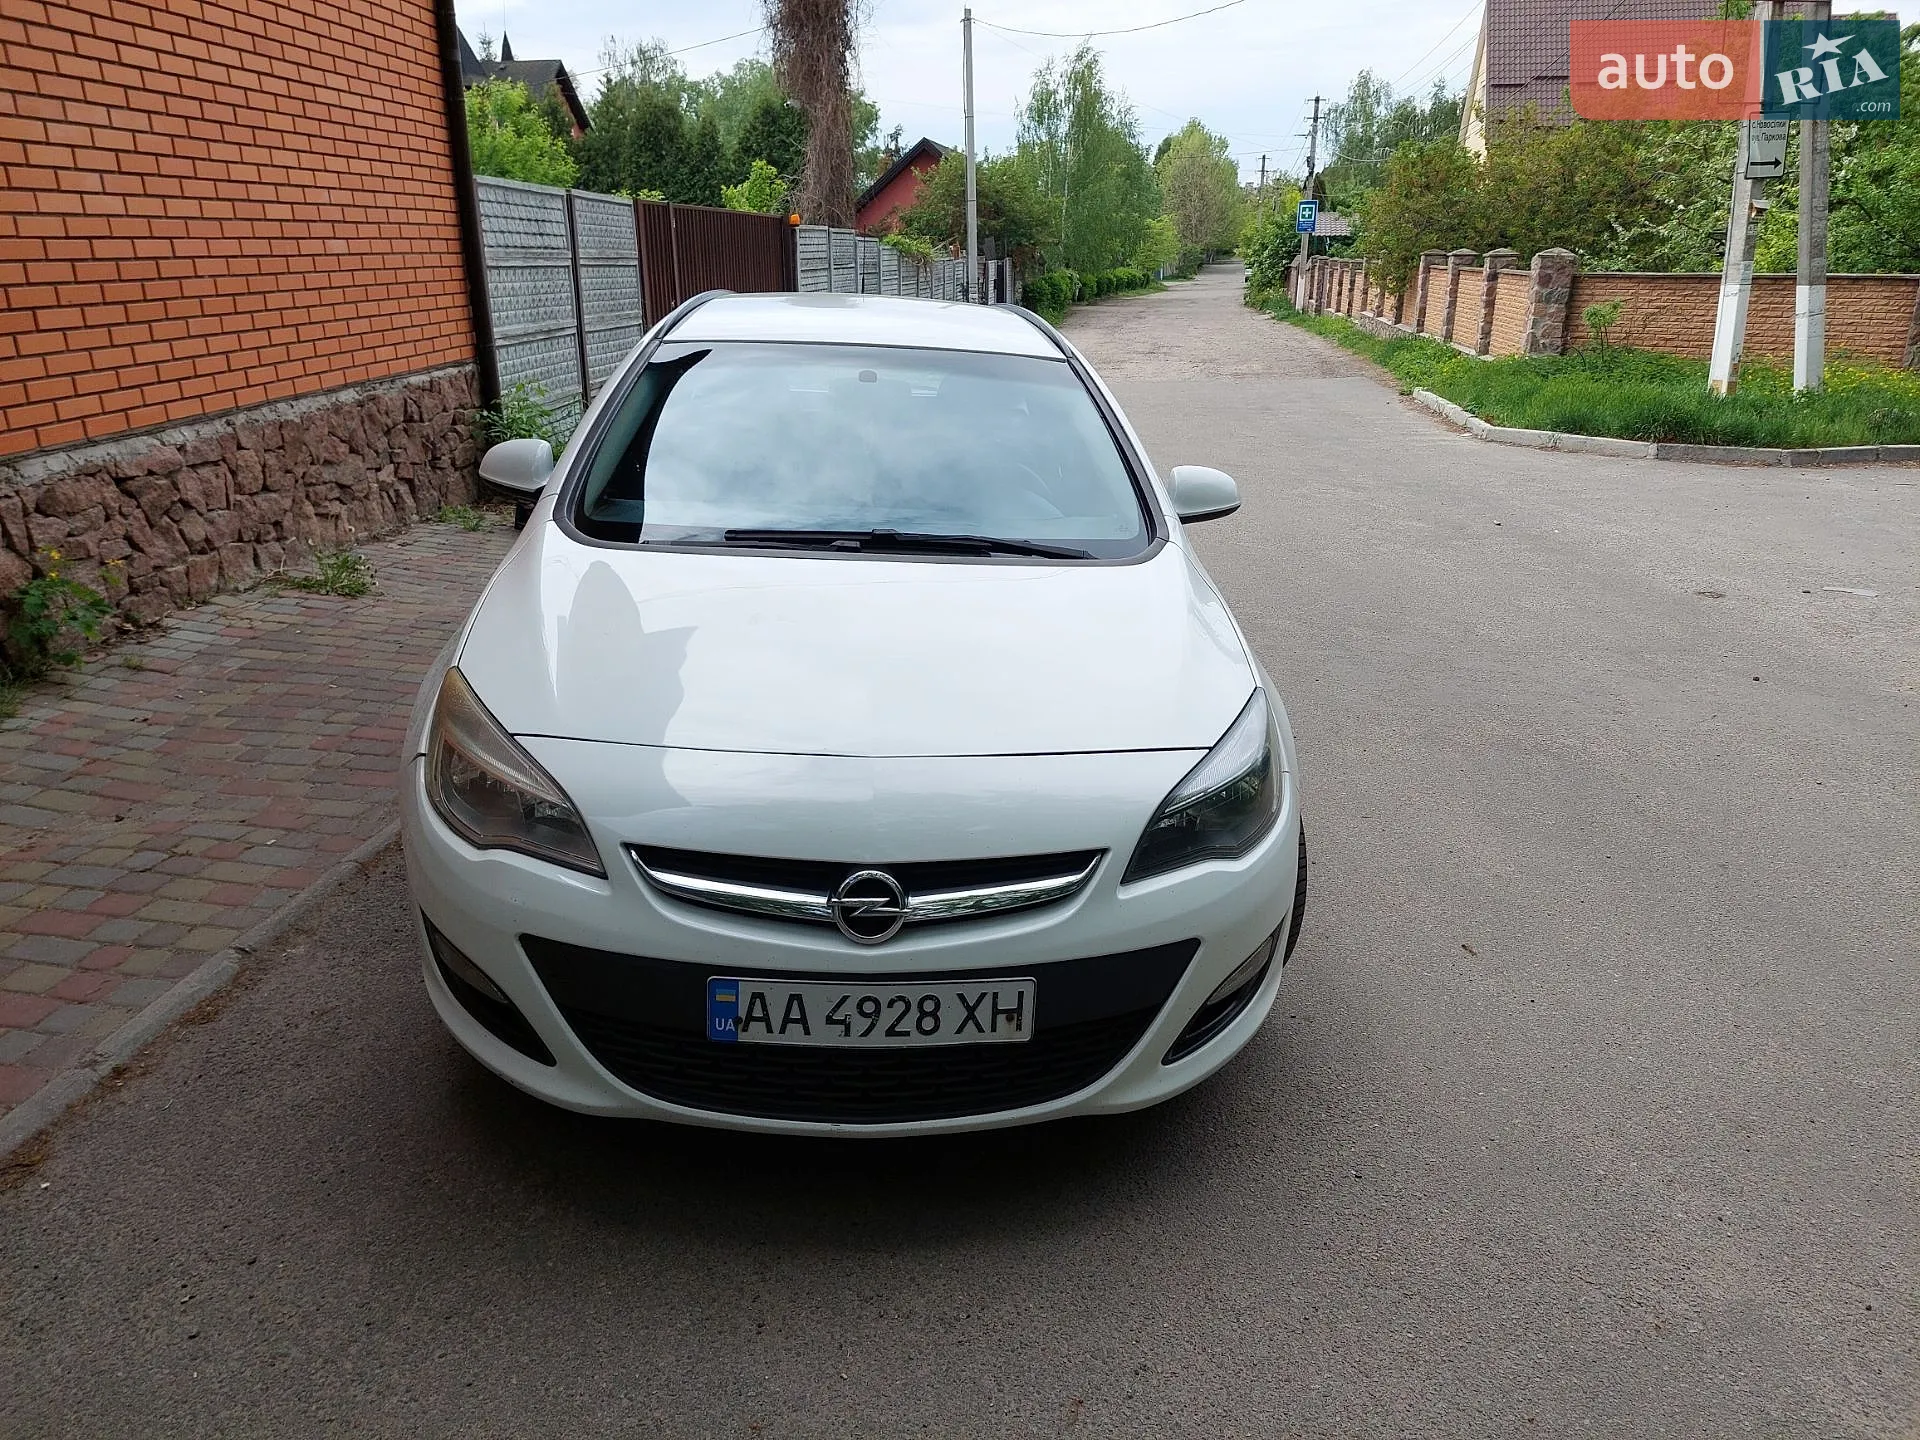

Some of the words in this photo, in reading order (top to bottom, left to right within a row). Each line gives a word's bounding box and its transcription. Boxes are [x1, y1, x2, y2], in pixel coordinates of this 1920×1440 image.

[715, 1016, 736, 1032] UA
[741, 991, 812, 1036] AA
[824, 993, 942, 1038] 4928
[953, 990, 1025, 1035] XH
